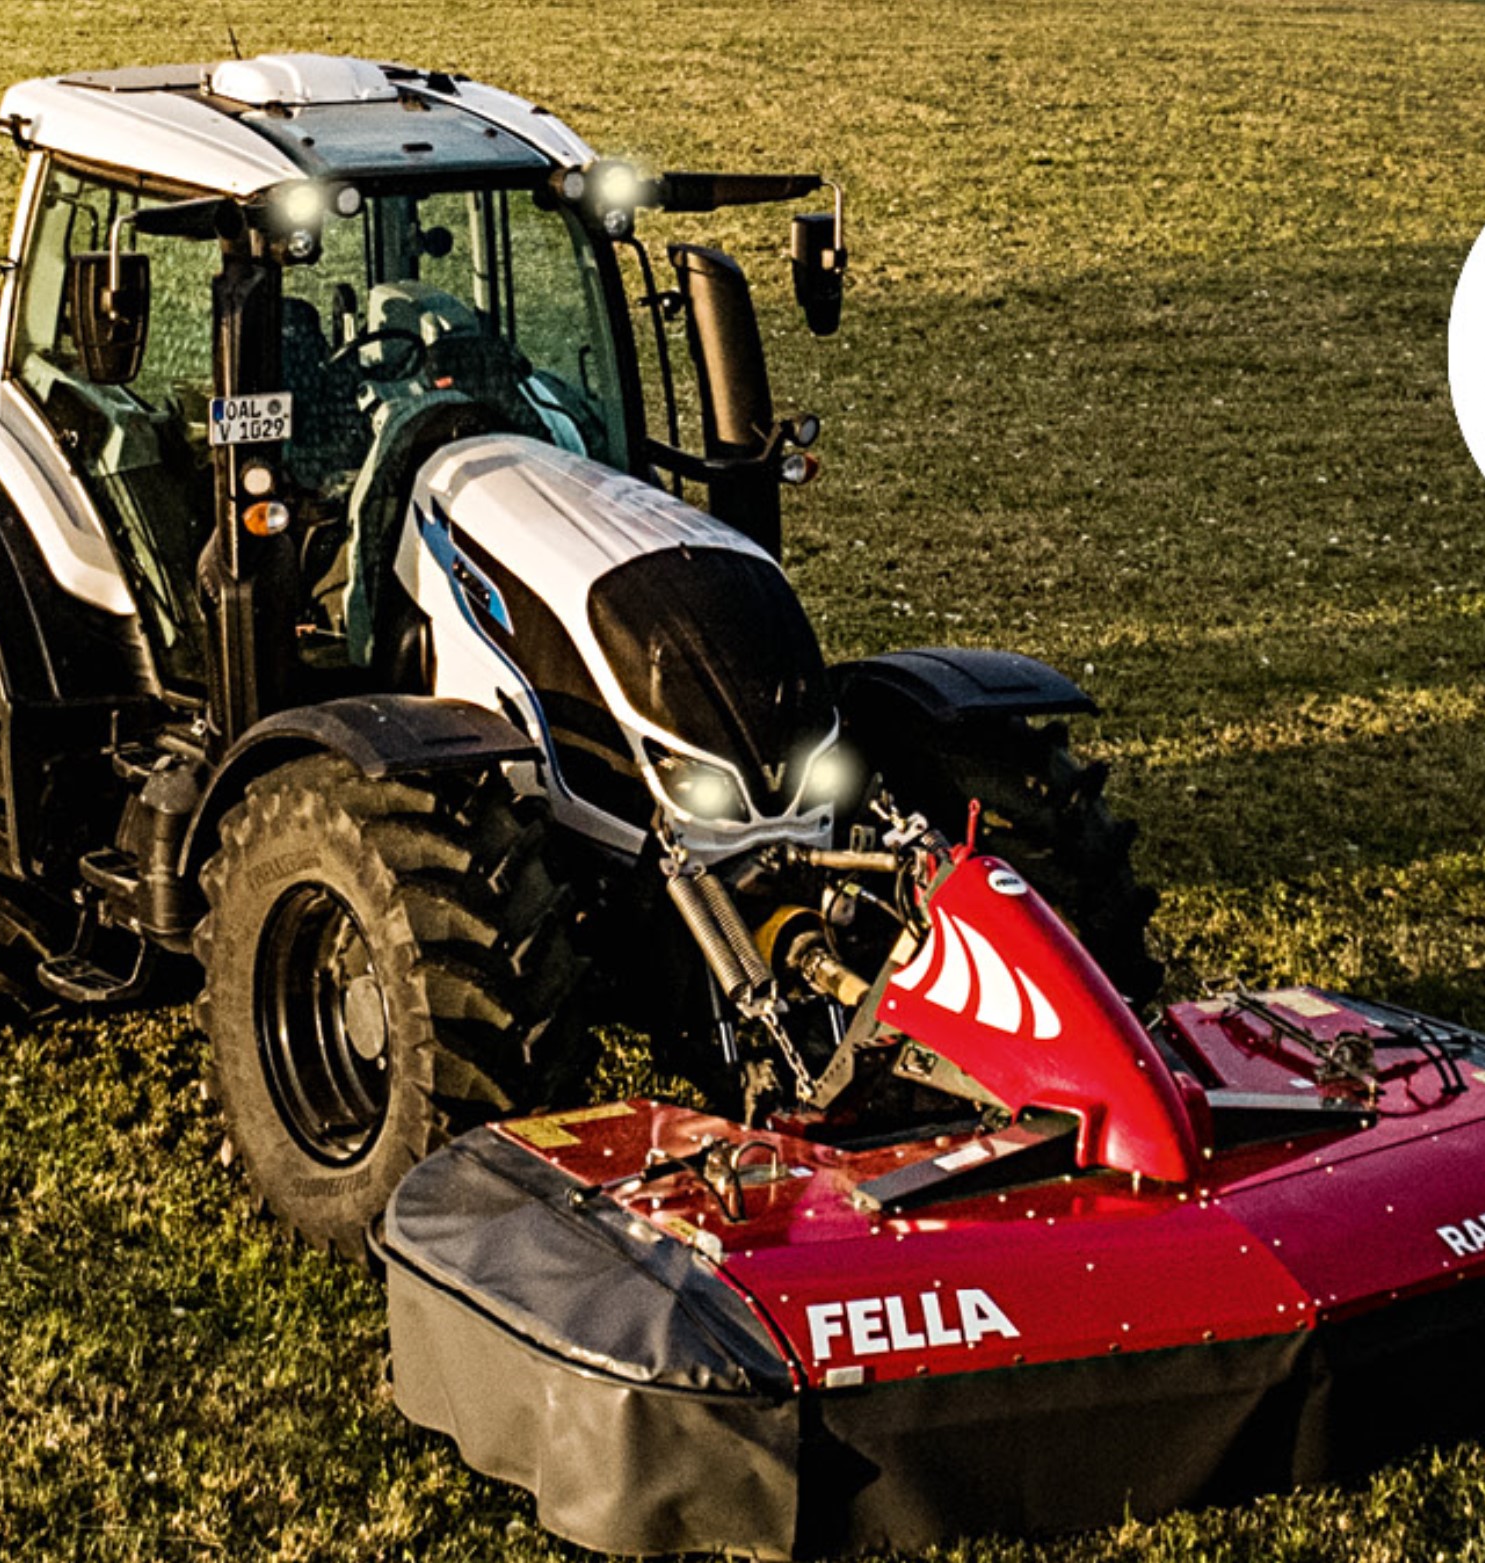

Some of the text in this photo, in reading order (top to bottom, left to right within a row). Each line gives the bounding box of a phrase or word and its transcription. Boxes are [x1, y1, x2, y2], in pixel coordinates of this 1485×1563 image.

[226, 401, 261, 420] OAL
[219, 418, 284, 442] V 1029
[805, 1288, 1021, 1361] FELLA
